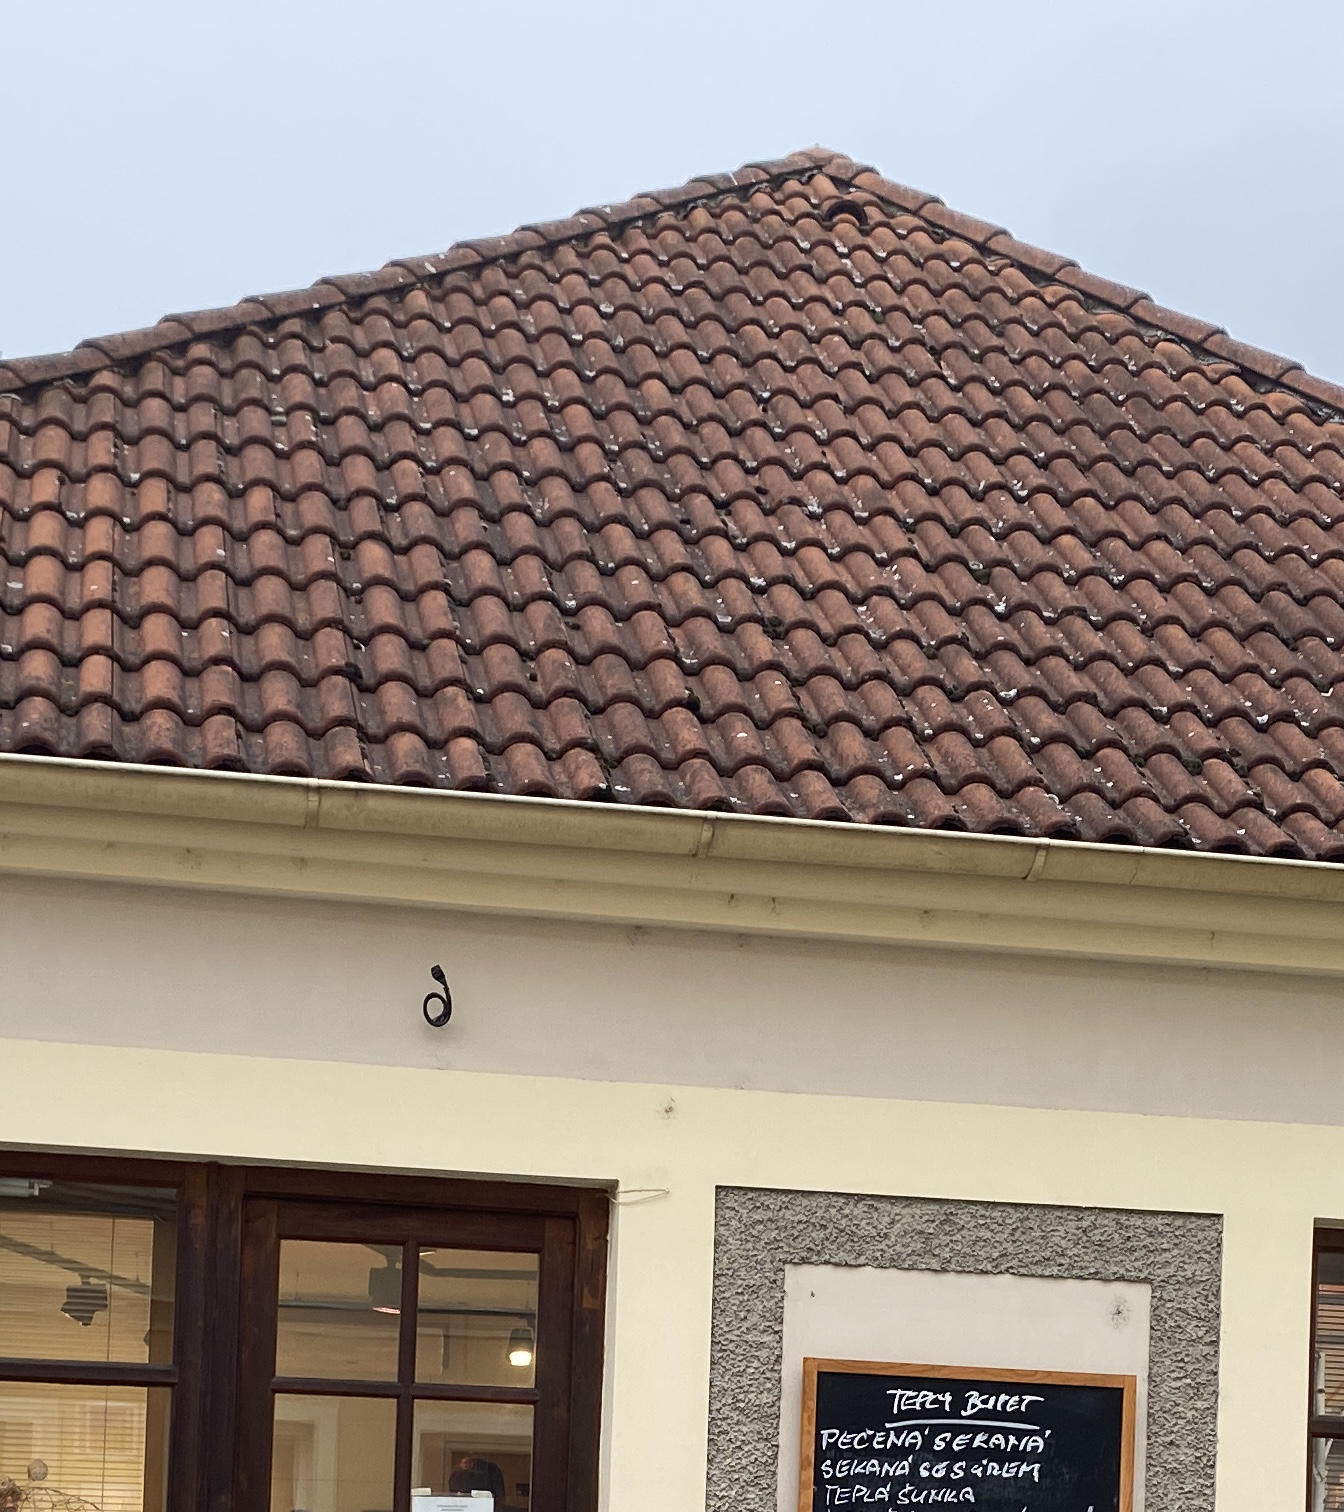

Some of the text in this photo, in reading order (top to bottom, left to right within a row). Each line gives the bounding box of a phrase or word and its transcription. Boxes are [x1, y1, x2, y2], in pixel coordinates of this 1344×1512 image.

[960, 1390, 1045, 1417] BUFET
[820, 1427, 1052, 1453] PEČENÁ SEKANÁ
[821, 1455, 914, 1478] SEKANÁ
[825, 1482, 976, 1505] TEPLÁ ŠUNKA
